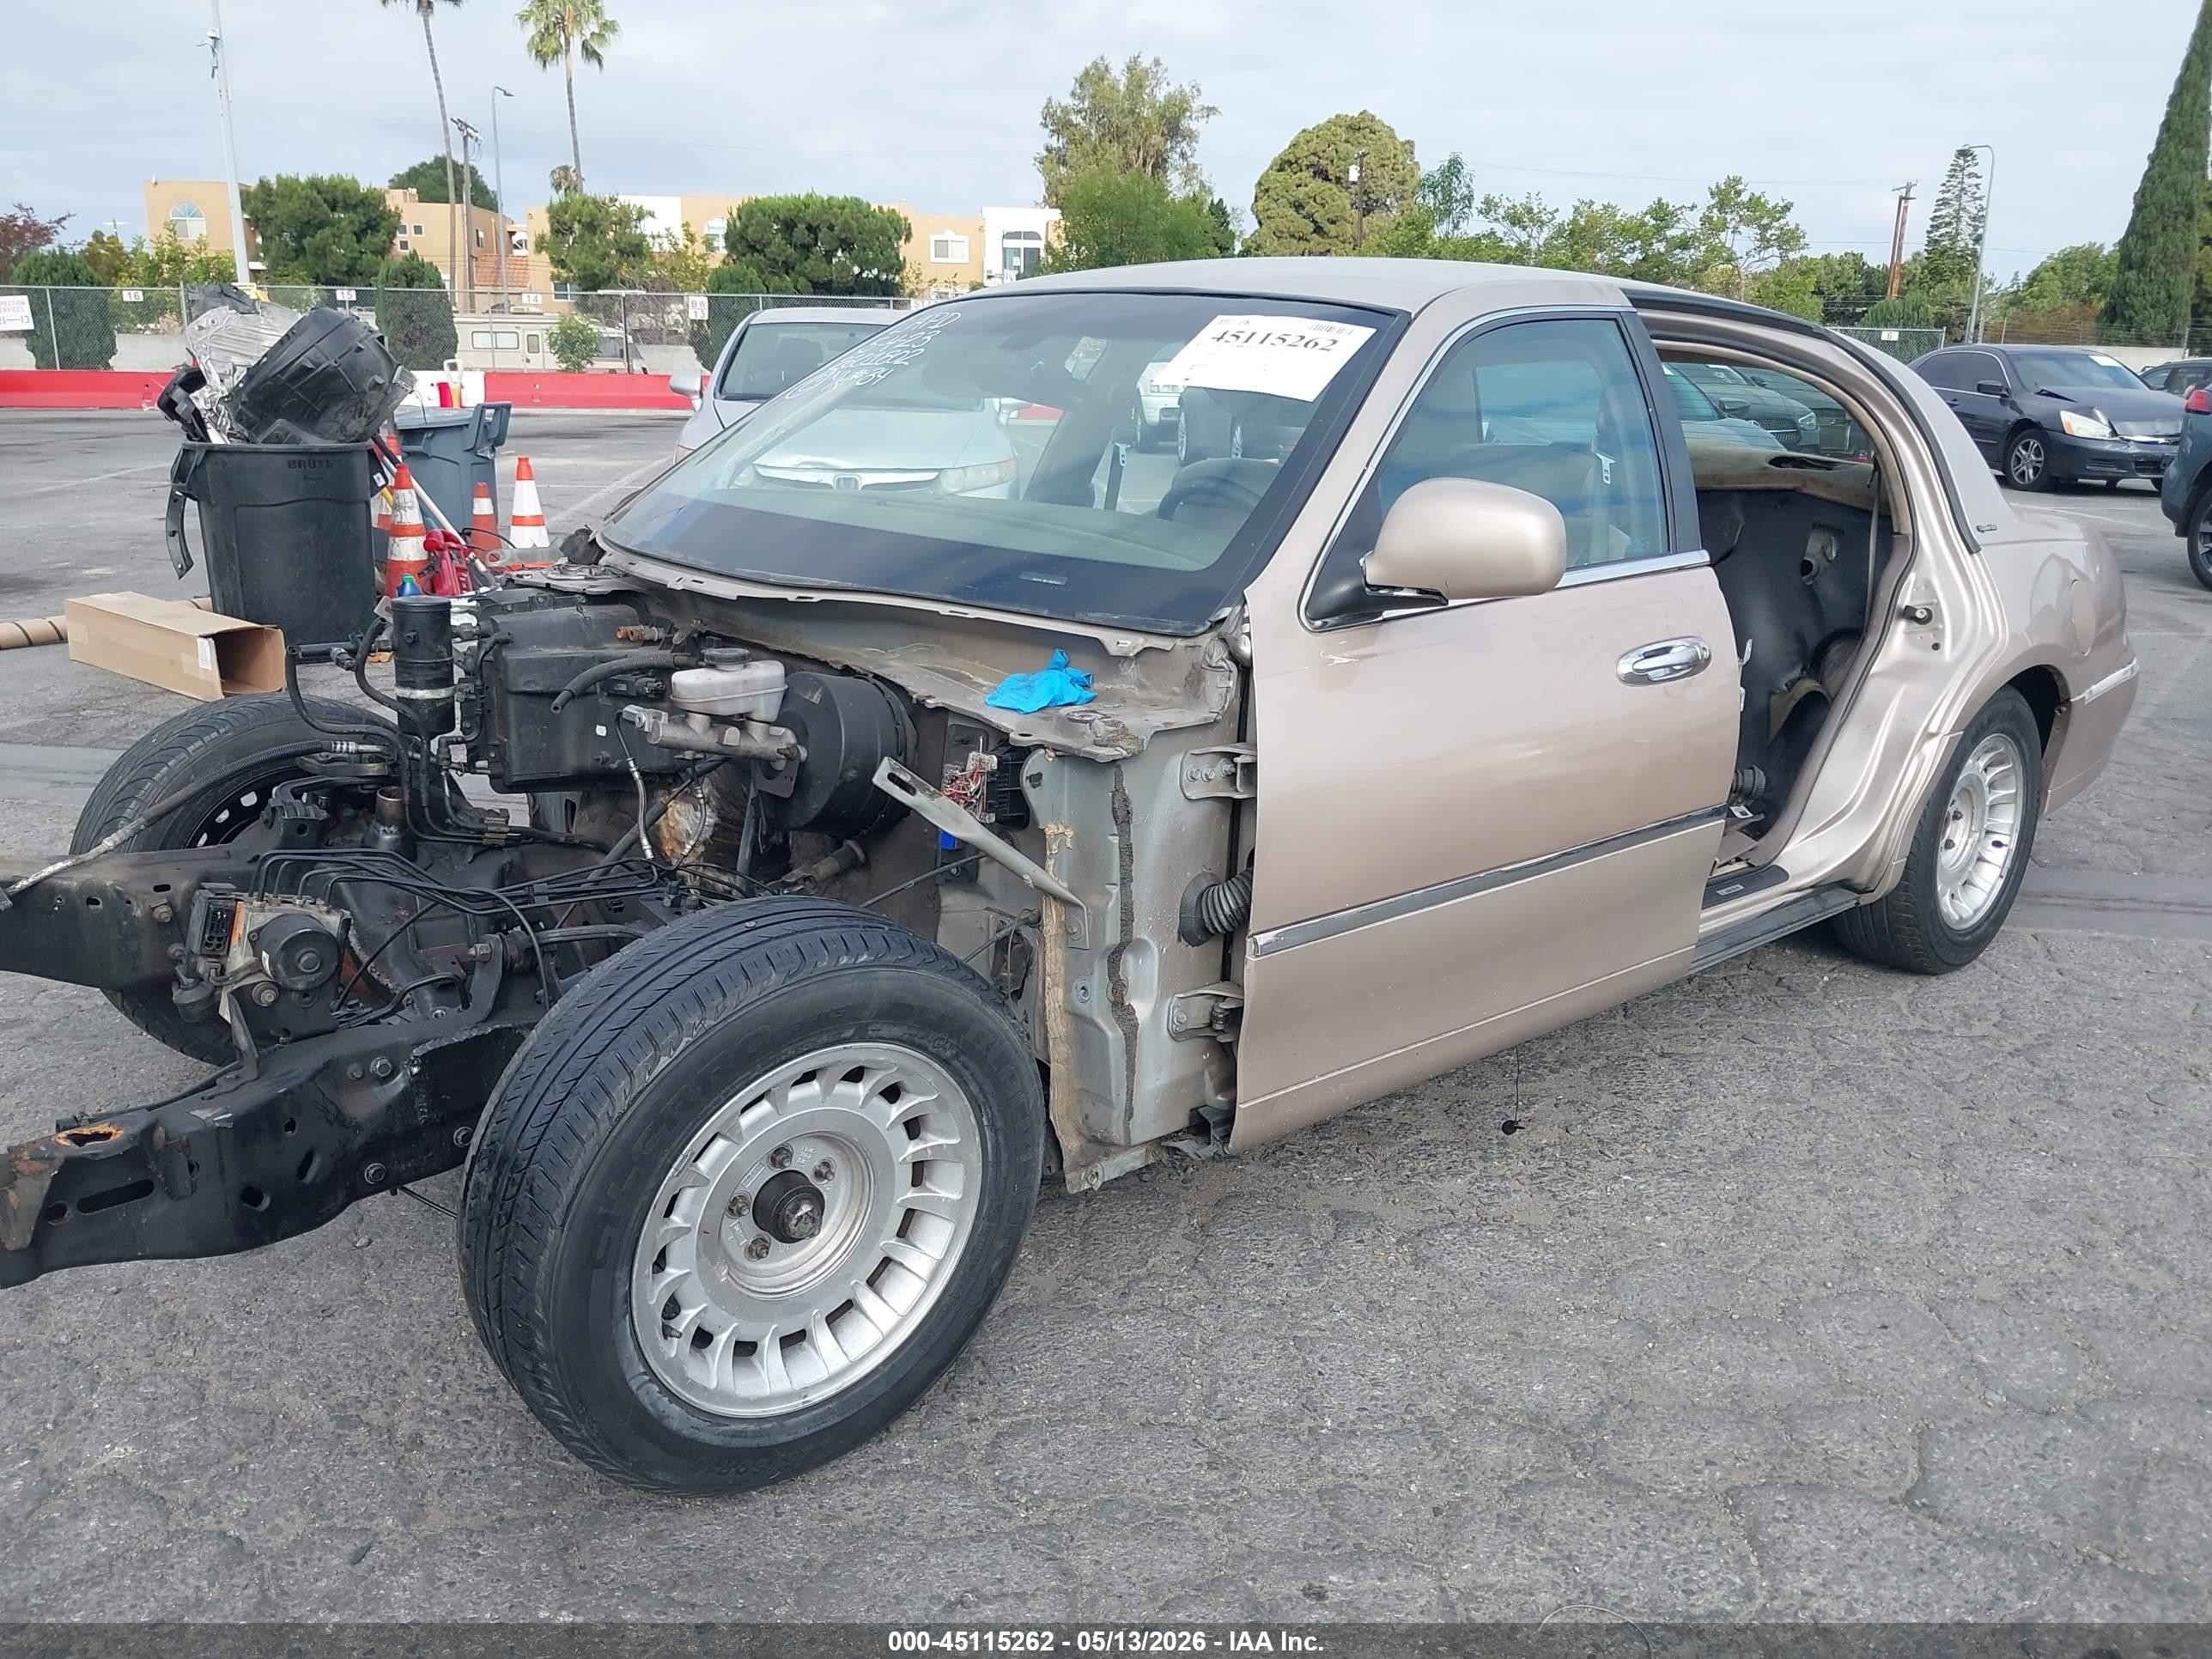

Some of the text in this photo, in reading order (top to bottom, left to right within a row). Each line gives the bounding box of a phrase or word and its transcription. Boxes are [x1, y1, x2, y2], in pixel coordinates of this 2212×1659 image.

[126, 291, 141, 301] 16
[340, 289, 353, 300] 15
[526, 295, 539, 303] 14
[690, 299, 706, 308] BW
[693, 309, 706, 319] 13
[1887, 331, 1893, 340] 6
[1210, 330, 1340, 352] 45115262
